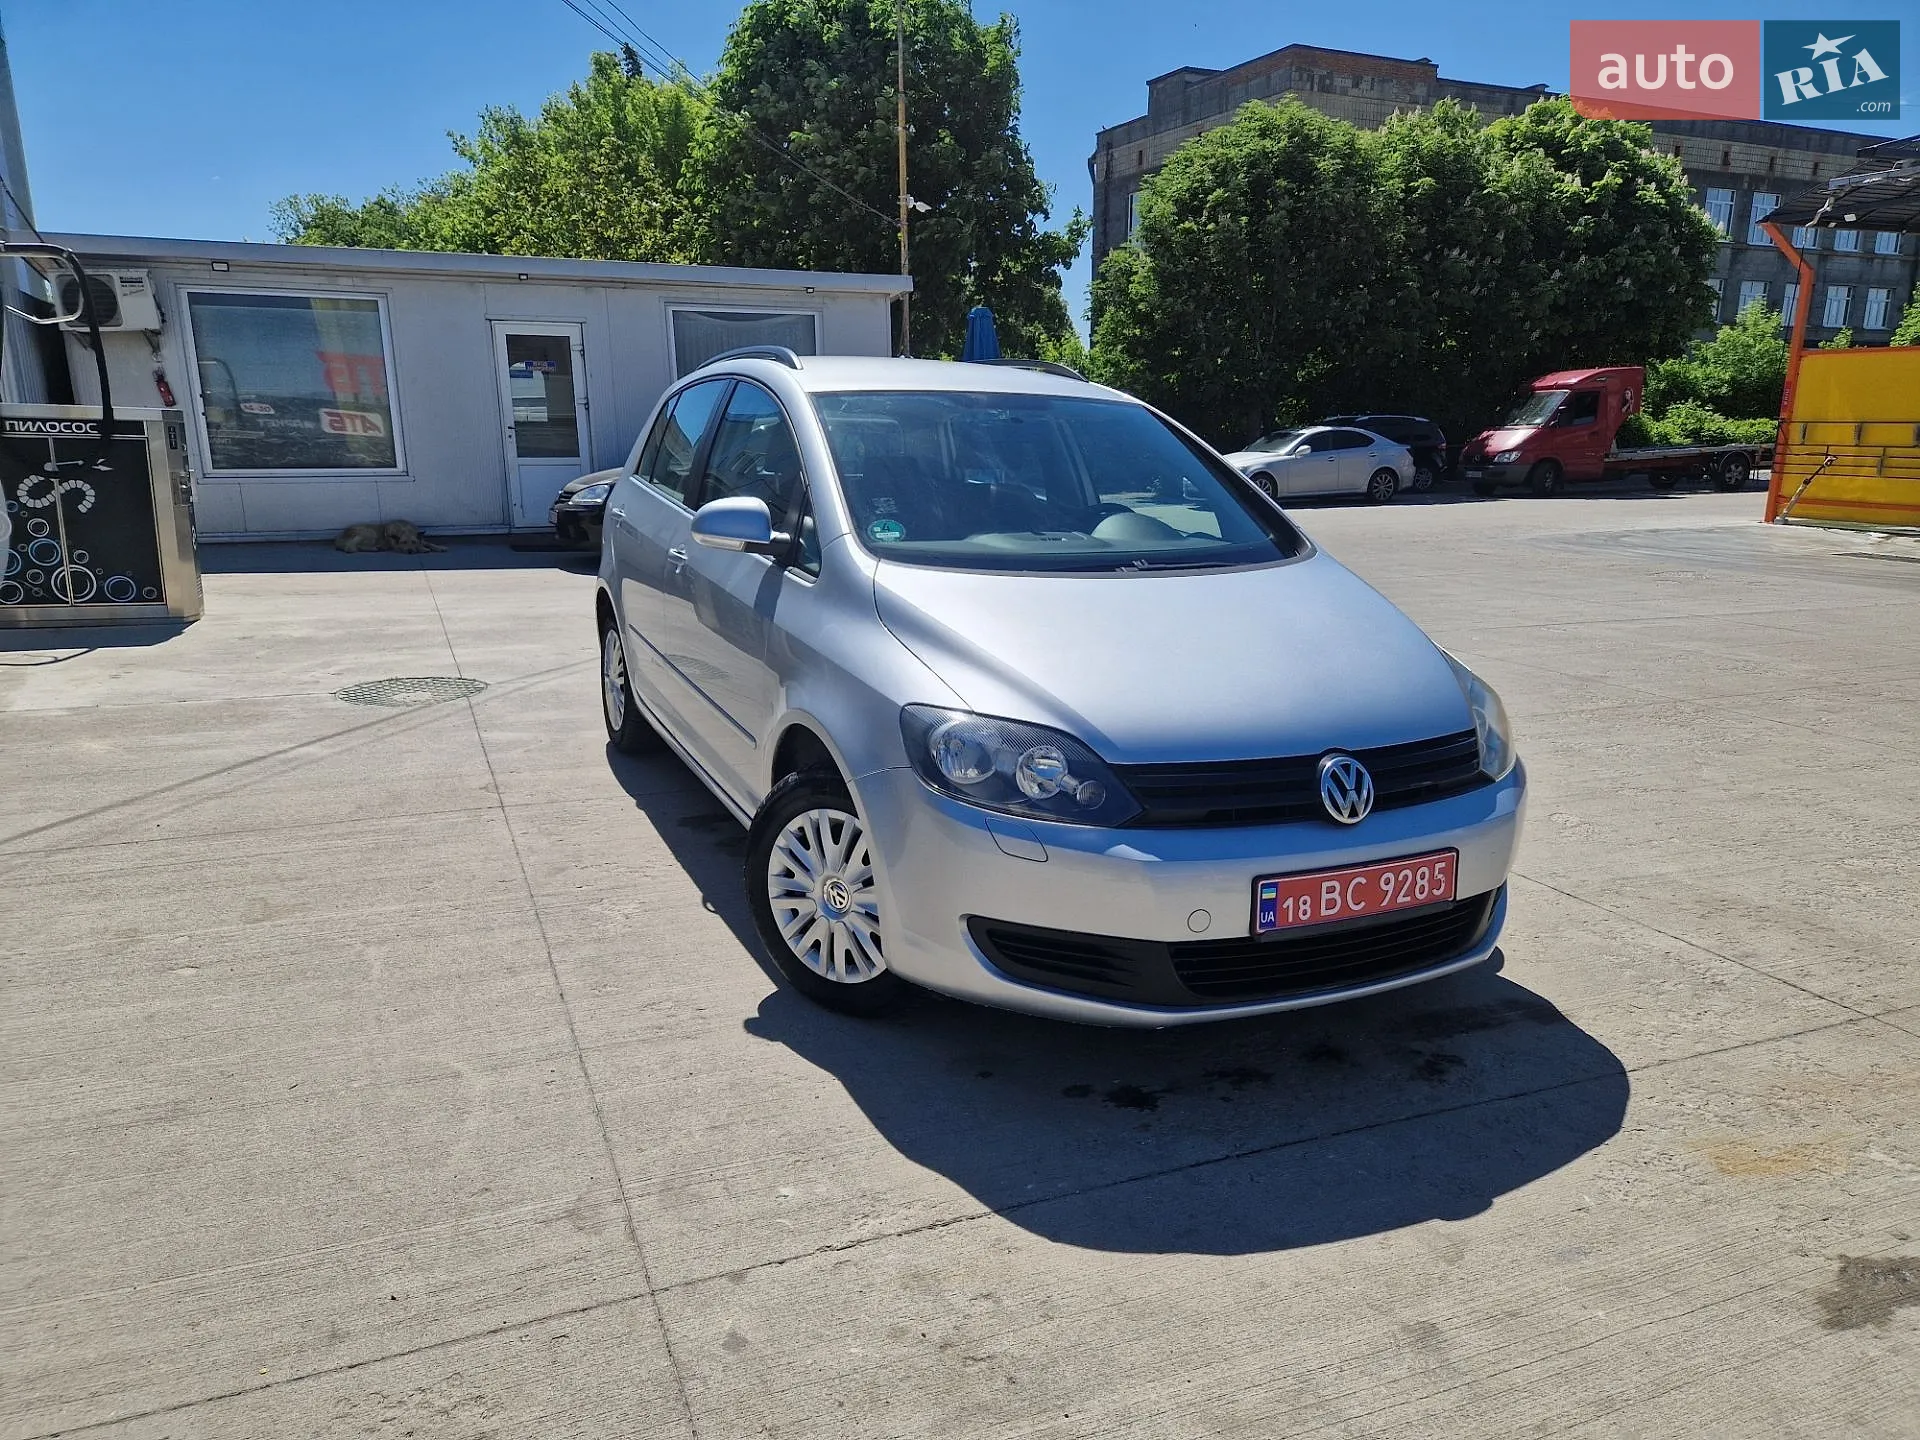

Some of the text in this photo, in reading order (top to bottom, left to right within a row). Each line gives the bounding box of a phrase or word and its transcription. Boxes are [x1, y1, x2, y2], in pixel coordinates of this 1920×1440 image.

[5, 420, 99, 433] ПИЛОСОС
[1282, 862, 1446, 922] 18 BC 9285
[1260, 911, 1275, 924] UA
